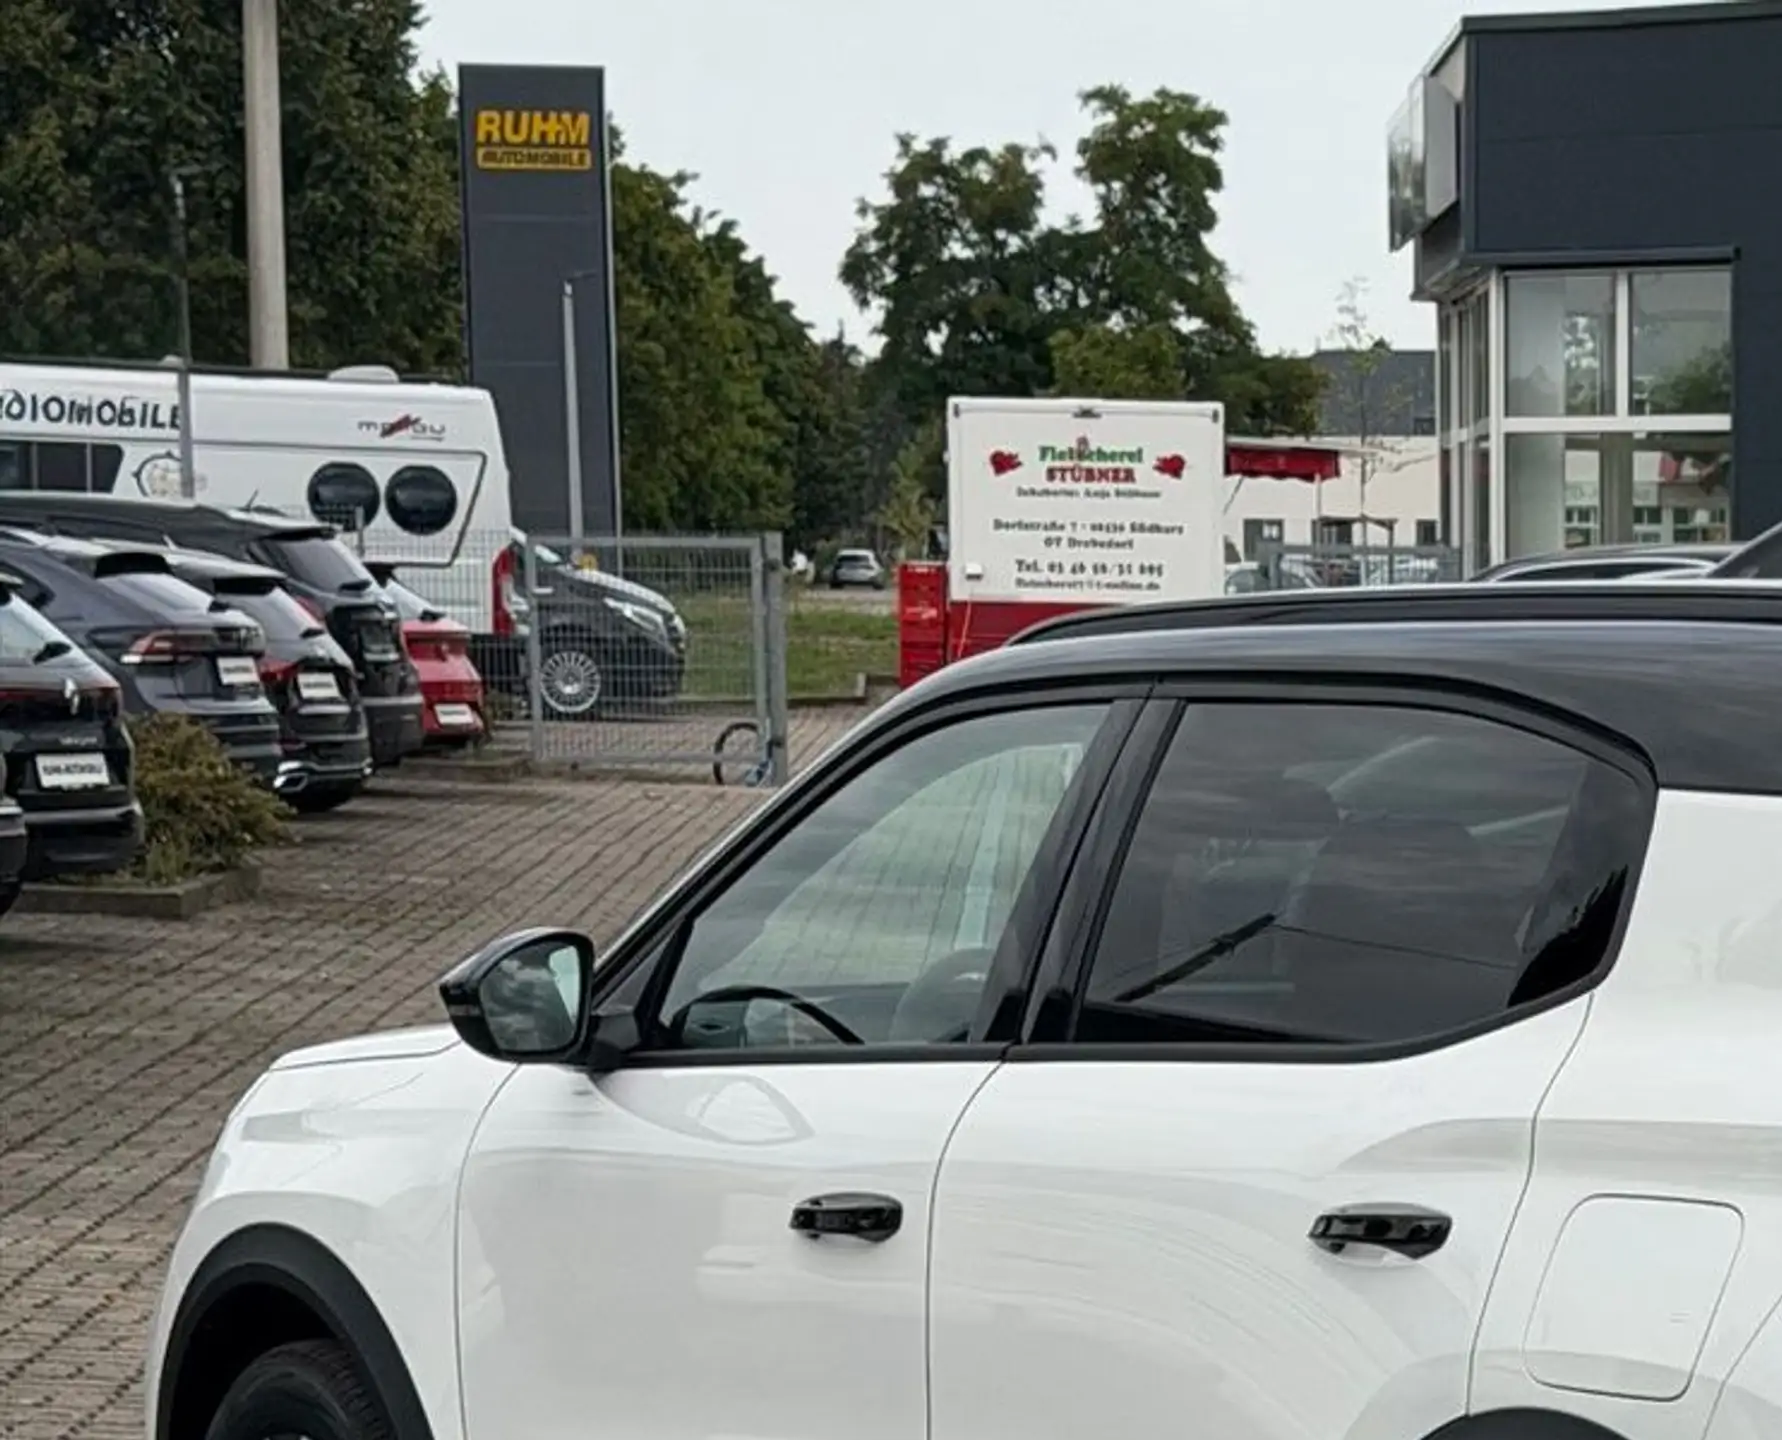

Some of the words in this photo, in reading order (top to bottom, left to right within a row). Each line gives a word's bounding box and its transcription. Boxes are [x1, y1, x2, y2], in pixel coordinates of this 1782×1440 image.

[476, 110, 590, 145] RUHM
[481, 150, 588, 165] AUTOMOBILE
[1015, 560, 1043, 573] Tel.
